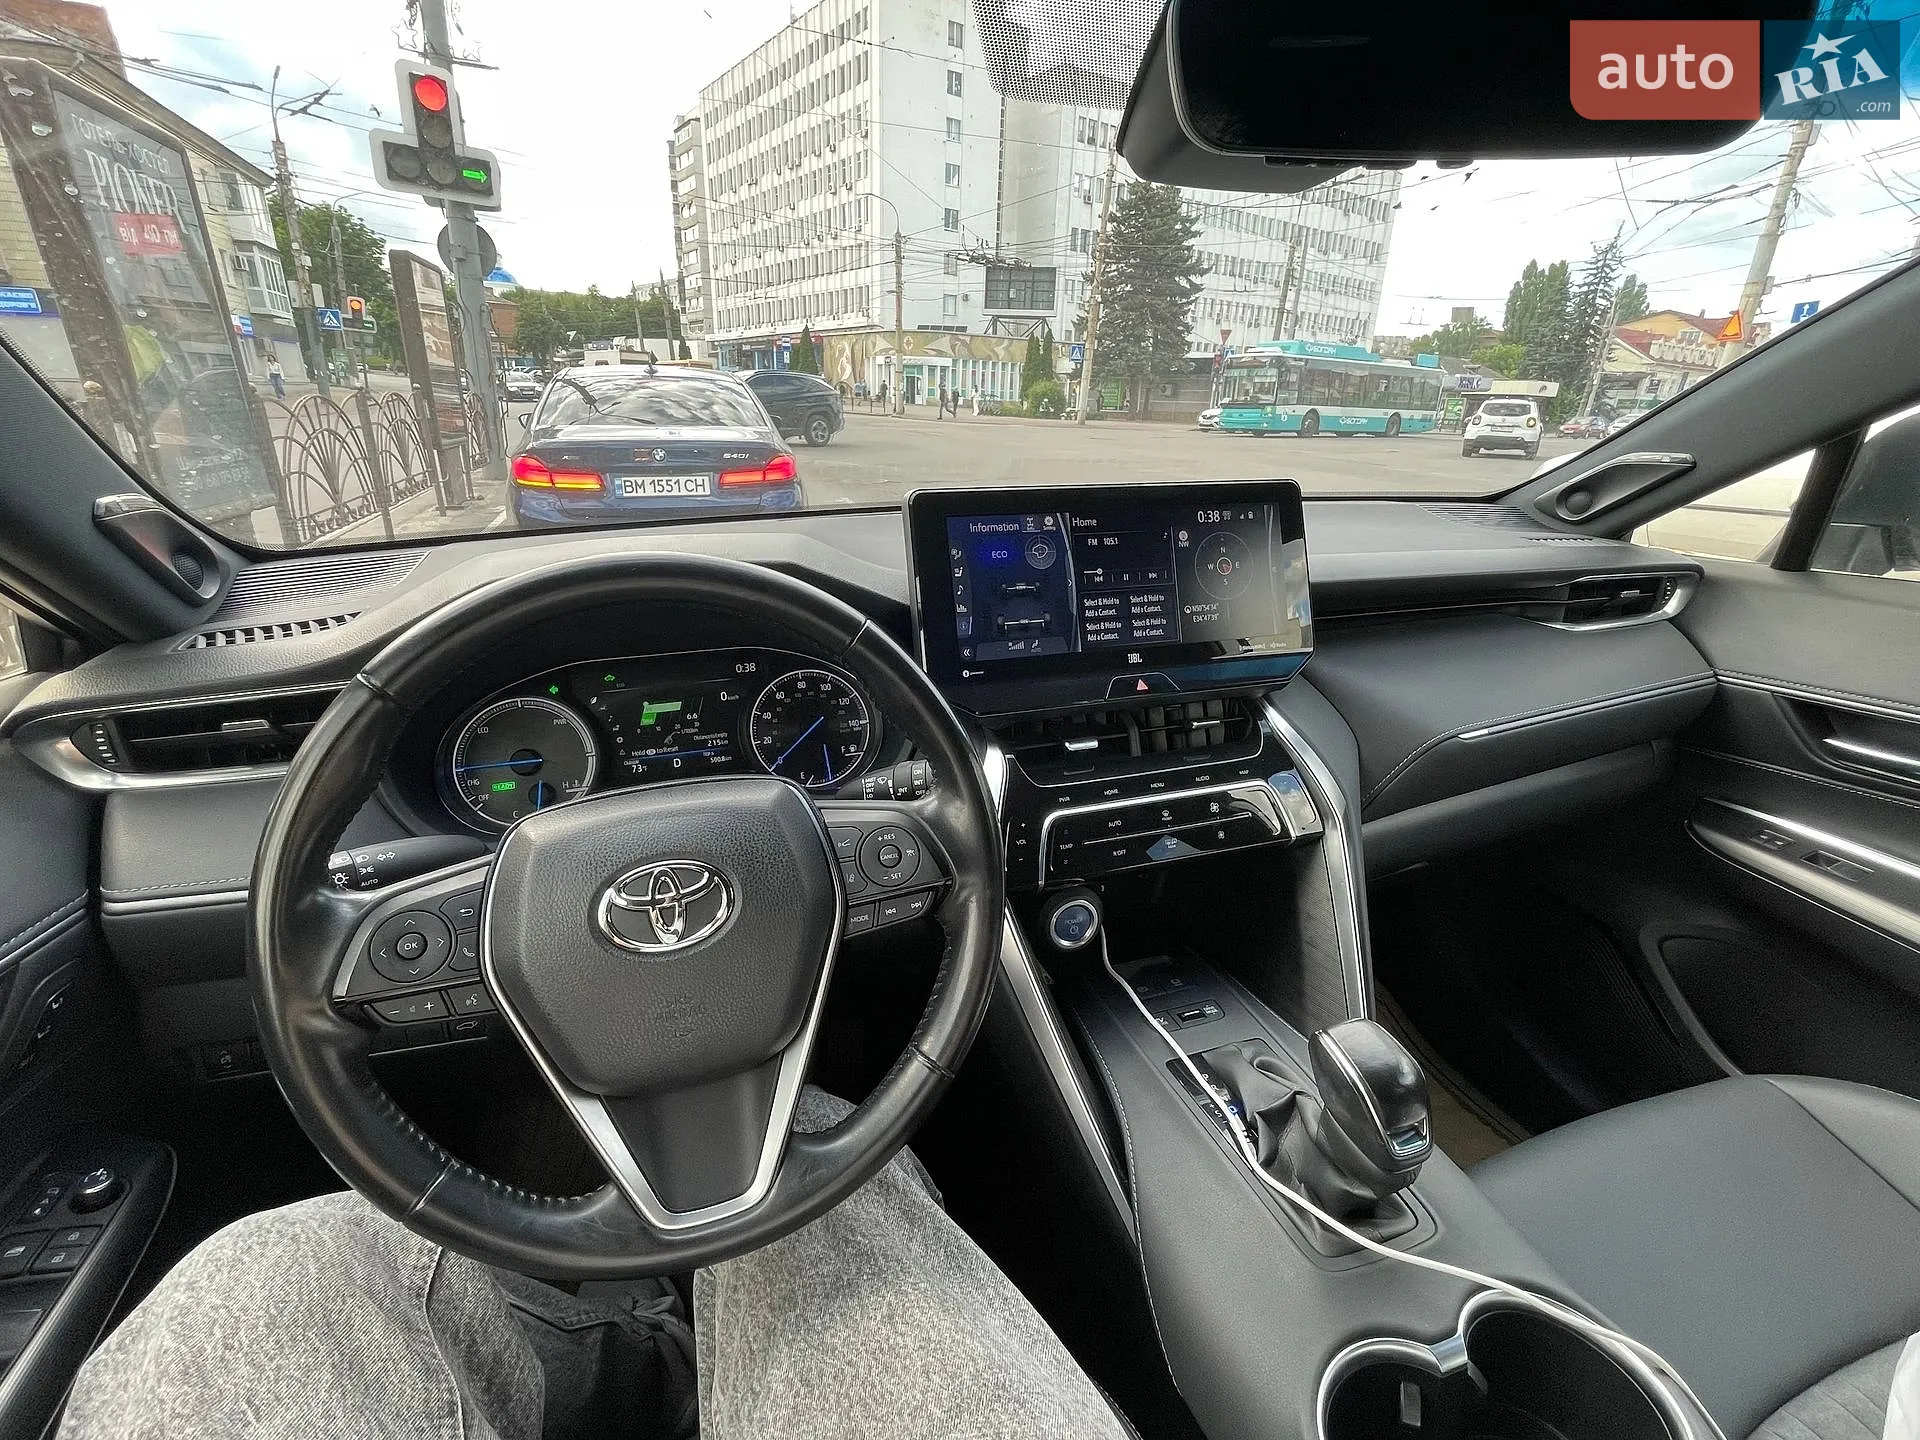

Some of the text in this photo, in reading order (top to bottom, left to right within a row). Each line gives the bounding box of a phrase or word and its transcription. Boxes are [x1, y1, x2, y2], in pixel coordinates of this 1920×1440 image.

[623, 478, 706, 494] BM 1551 CH
[1197, 510, 1220, 523] 0:38
[1072, 517, 1097, 527] Home
[969, 523, 1020, 533] Information
[1087, 537, 1118, 546] FM 105.1
[991, 550, 1008, 559] ECO
[1084, 599, 1098, 607] Select
[1103, 597, 1114, 605] Hold
[1130, 595, 1144, 603] Select
[1148, 594, 1158, 602] Hold
[1085, 609, 1095, 617] Add
[1131, 606, 1140, 614] Add
[1086, 623, 1100, 631] Select
[1105, 621, 1116, 629] Hold
[1132, 619, 1145, 627] Select
[1087, 633, 1096, 641] Add
[1128, 653, 1142, 663] JBL
[735, 663, 757, 673] 0:38
[797, 681, 806, 689] 80
[720, 692, 727, 701] 0
[775, 691, 785, 700] 60
[762, 712, 772, 720] 40
[554, 718, 567, 726] PWR
[763, 736, 772, 744] 20
[673, 758, 681, 768] D
[467, 779, 480, 787] CHG
[1104, 788, 1119, 796] HOME
[513, 810, 519, 819] C
[1108, 820, 1122, 828] AUTO
[361, 878, 379, 887] AUTO
[850, 914, 870, 923] MODE
[404, 941, 418, 950] OK
[1202, 1073, 1209, 1081] P
